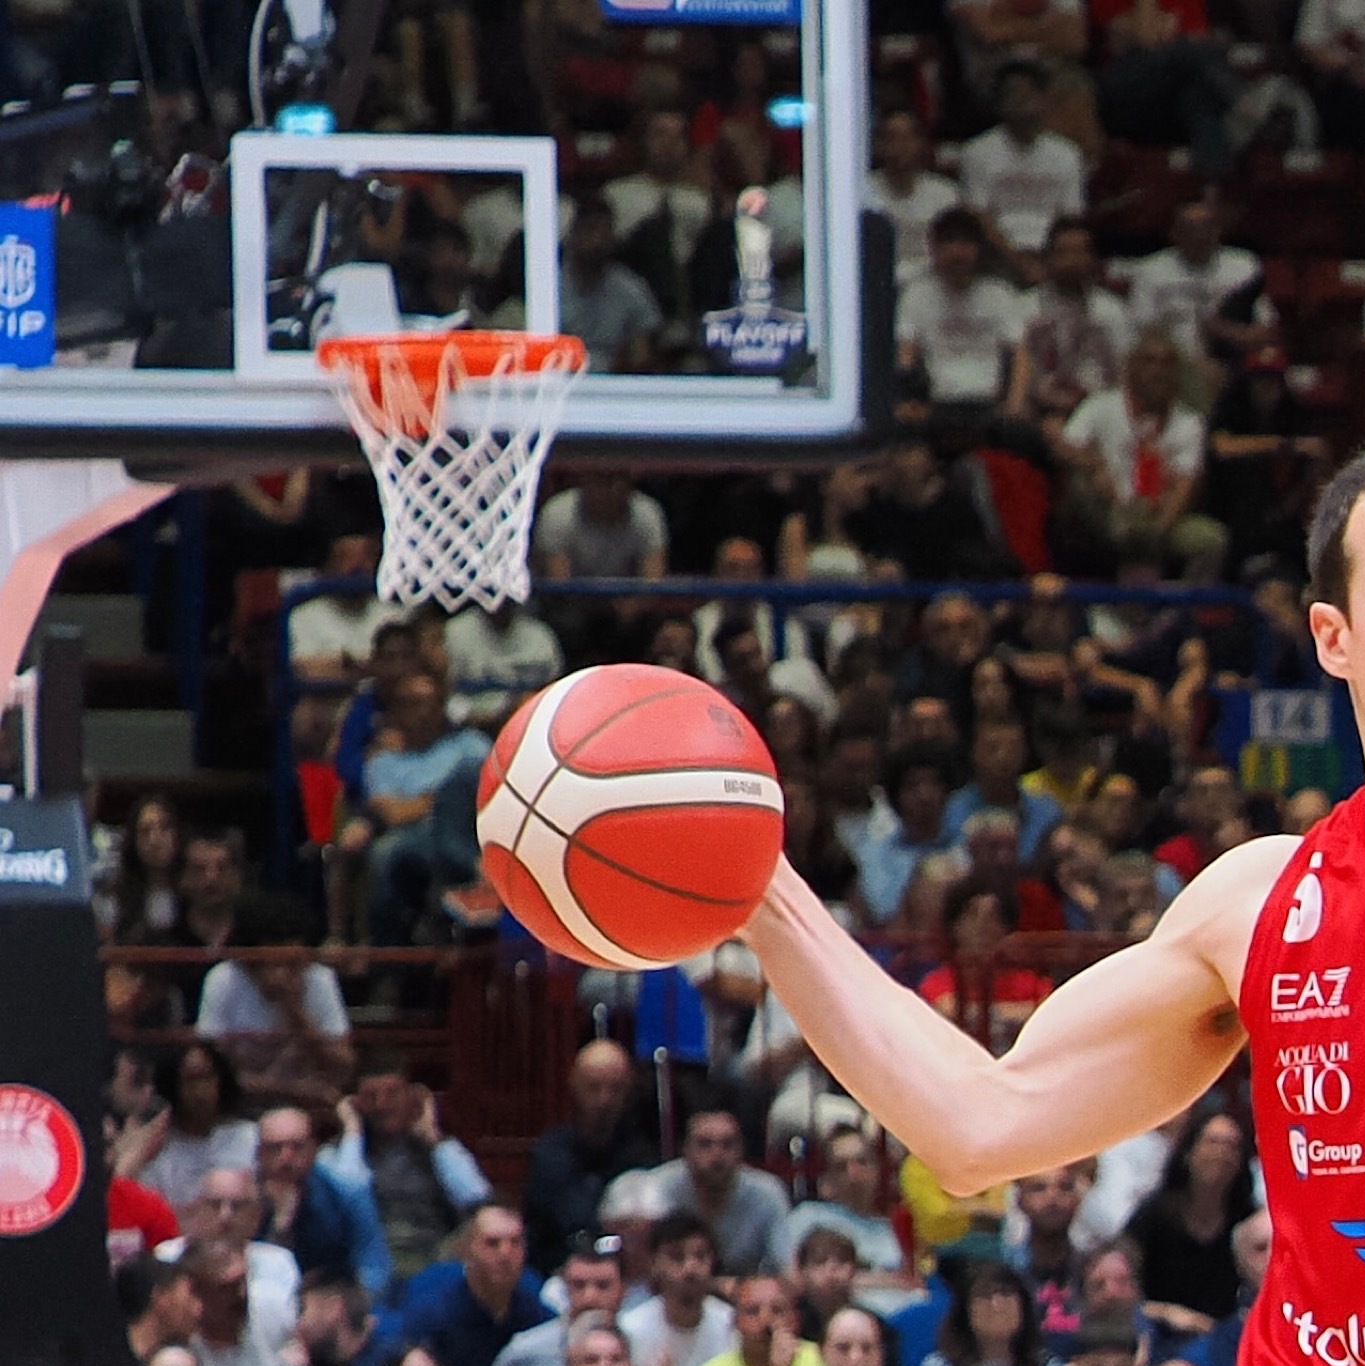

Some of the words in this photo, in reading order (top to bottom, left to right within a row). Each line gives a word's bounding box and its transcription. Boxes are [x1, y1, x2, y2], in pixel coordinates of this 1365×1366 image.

[0, 310, 46, 340] IP
[1270, 965, 1352, 1011] EA7
[1308, 1139, 1363, 1166] Group
